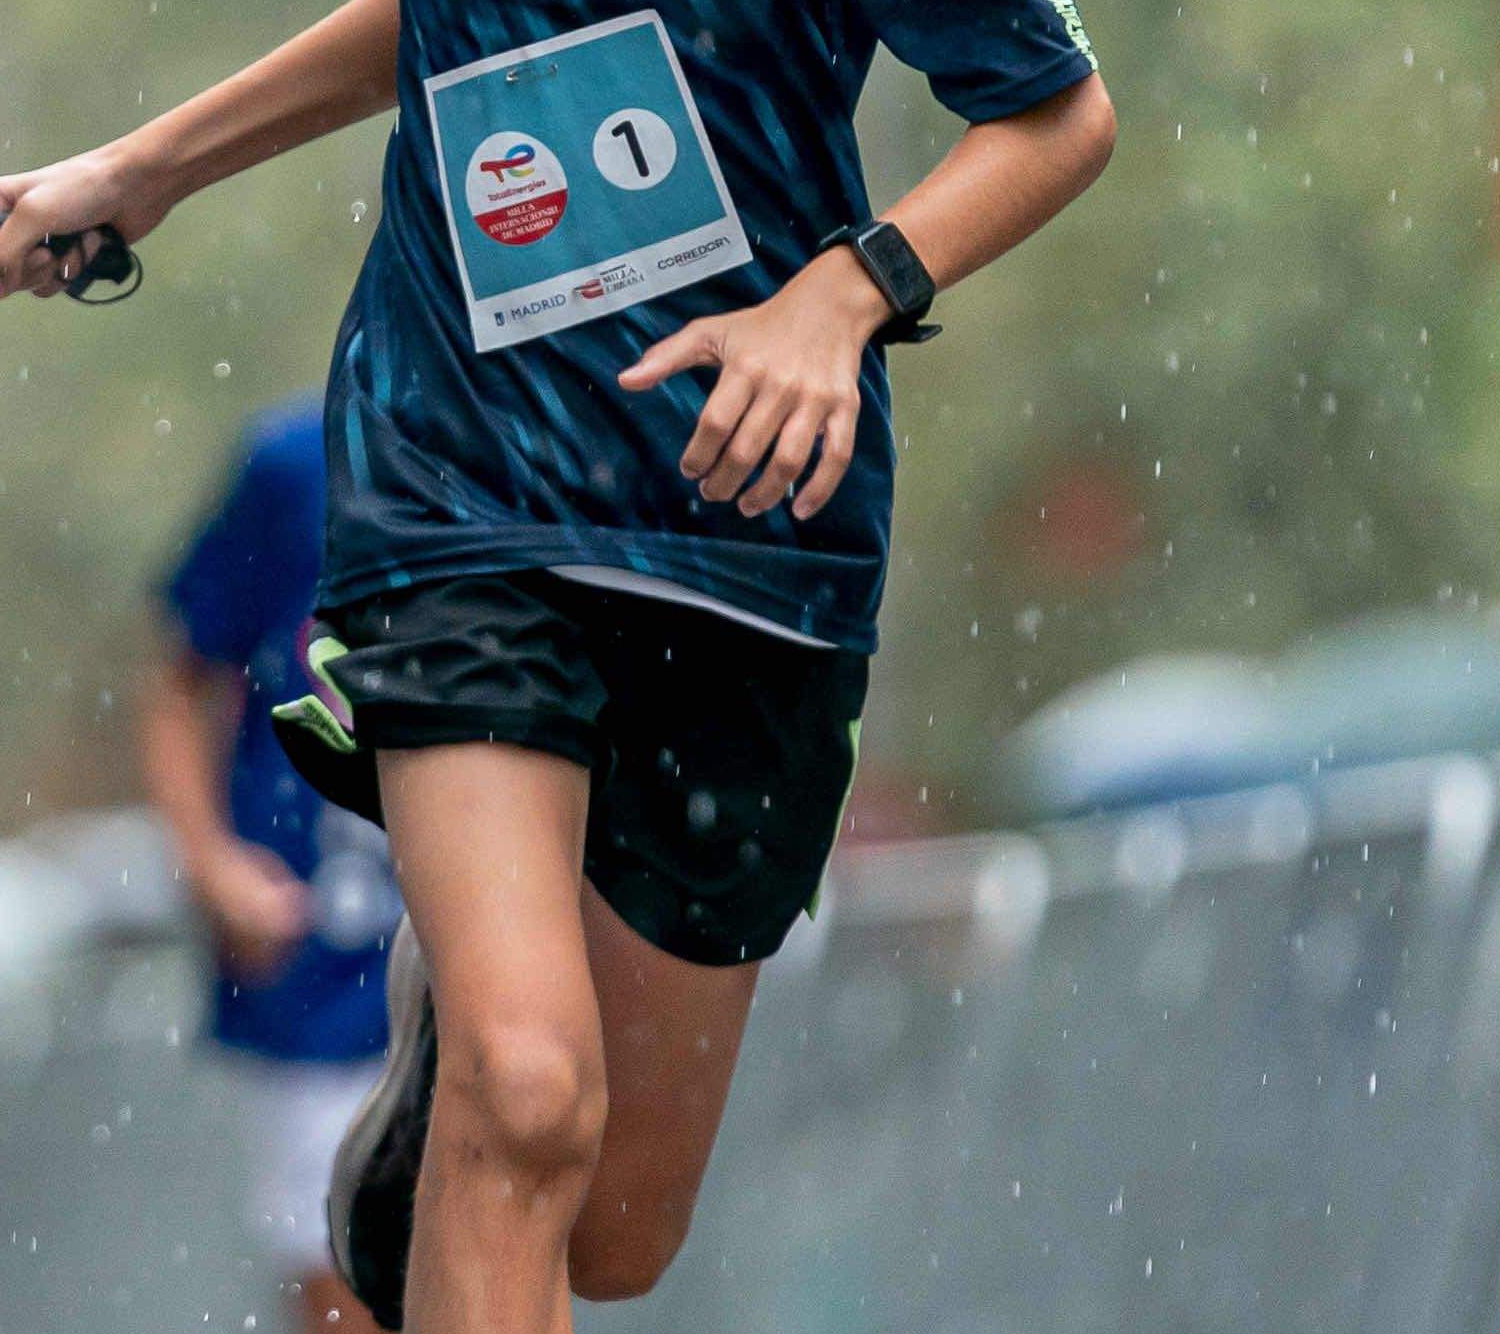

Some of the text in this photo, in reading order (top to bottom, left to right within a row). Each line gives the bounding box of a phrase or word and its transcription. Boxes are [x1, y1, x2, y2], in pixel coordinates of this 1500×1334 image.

[611, 120, 650, 178] 1
[602, 267, 637, 283] MILLA
[510, 293, 567, 321] MADRID
